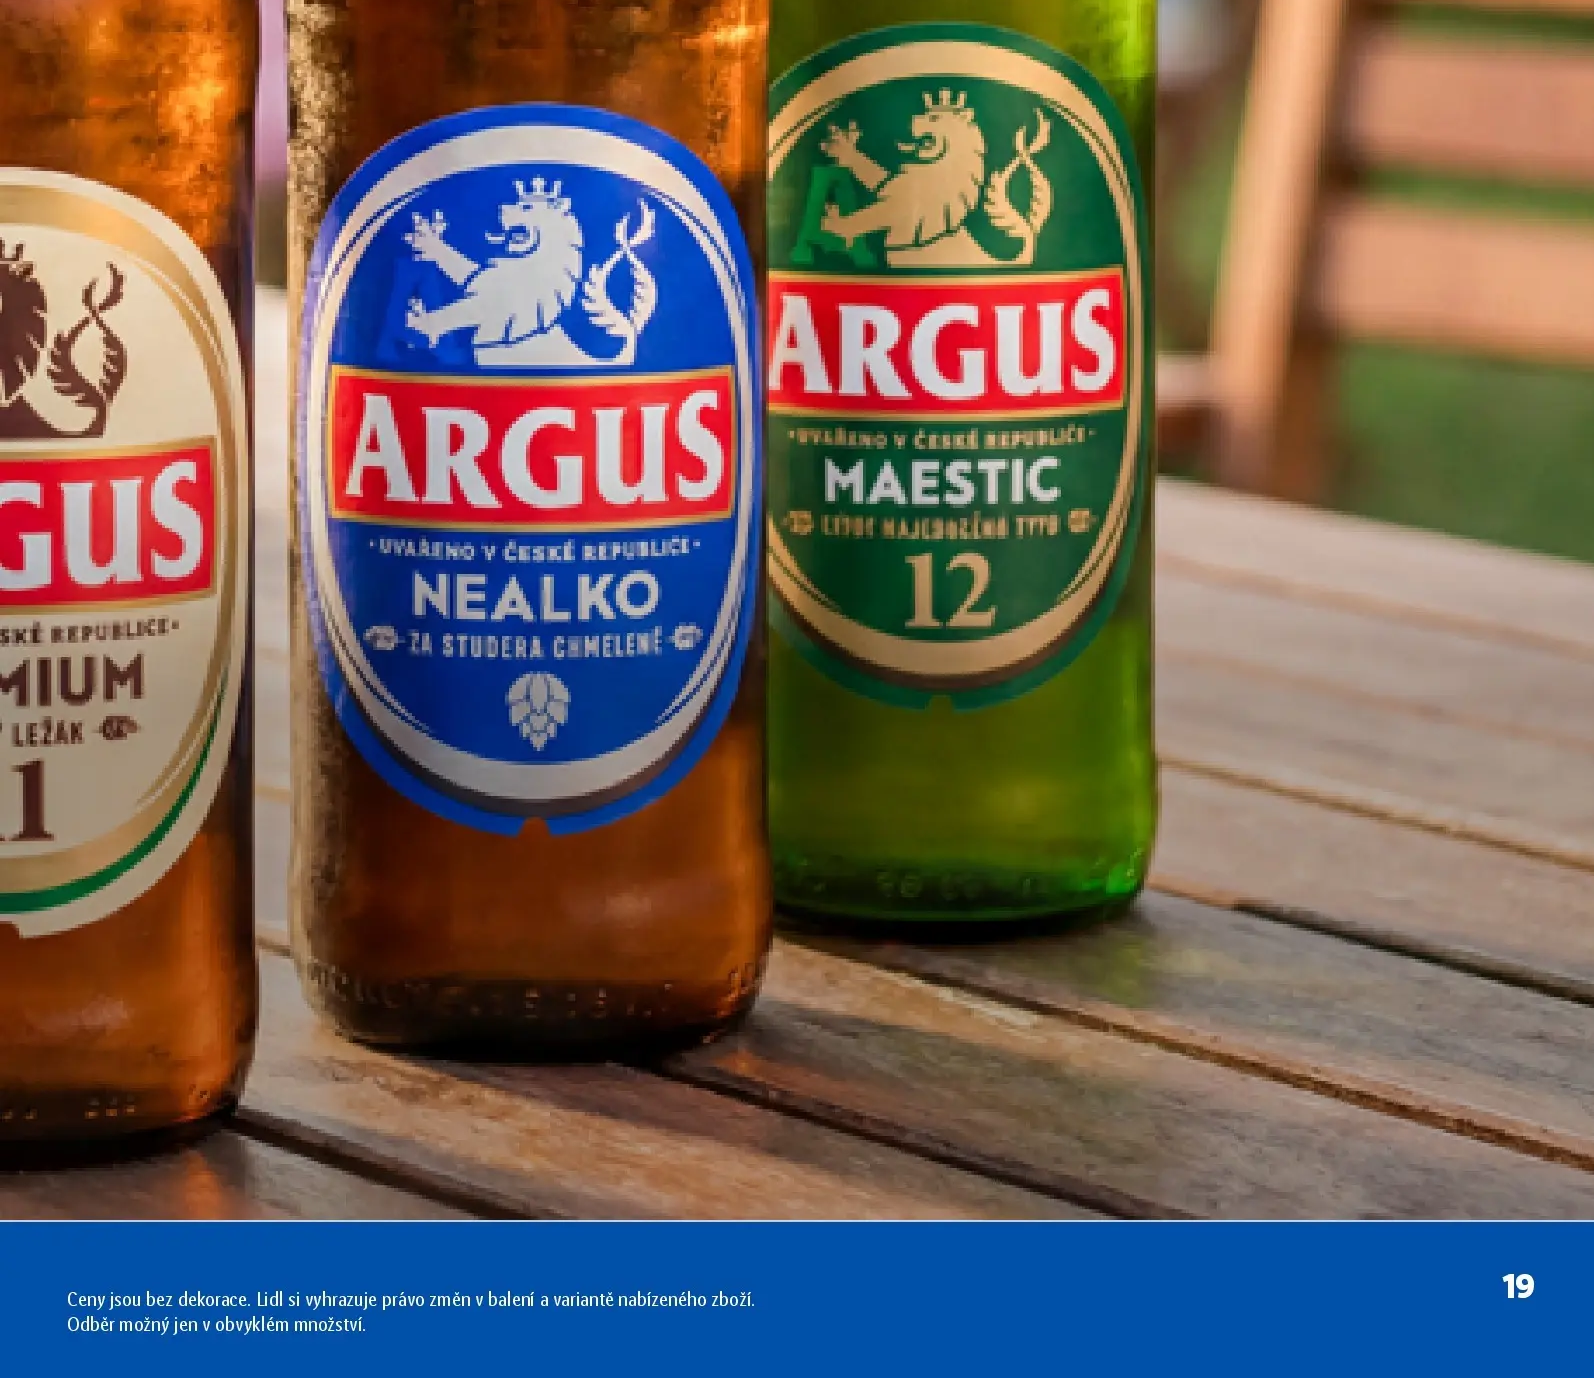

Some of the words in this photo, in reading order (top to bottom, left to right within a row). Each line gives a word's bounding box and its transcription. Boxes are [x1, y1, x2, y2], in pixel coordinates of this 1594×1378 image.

[769, 288, 1116, 400] ARGUS
[345, 389, 724, 509] ARGUS
[825, 456, 1062, 508] MAESTIC
[412, 570, 661, 622] NEALKO
[905, 552, 997, 629] 12
[0, 758, 55, 841] 1
